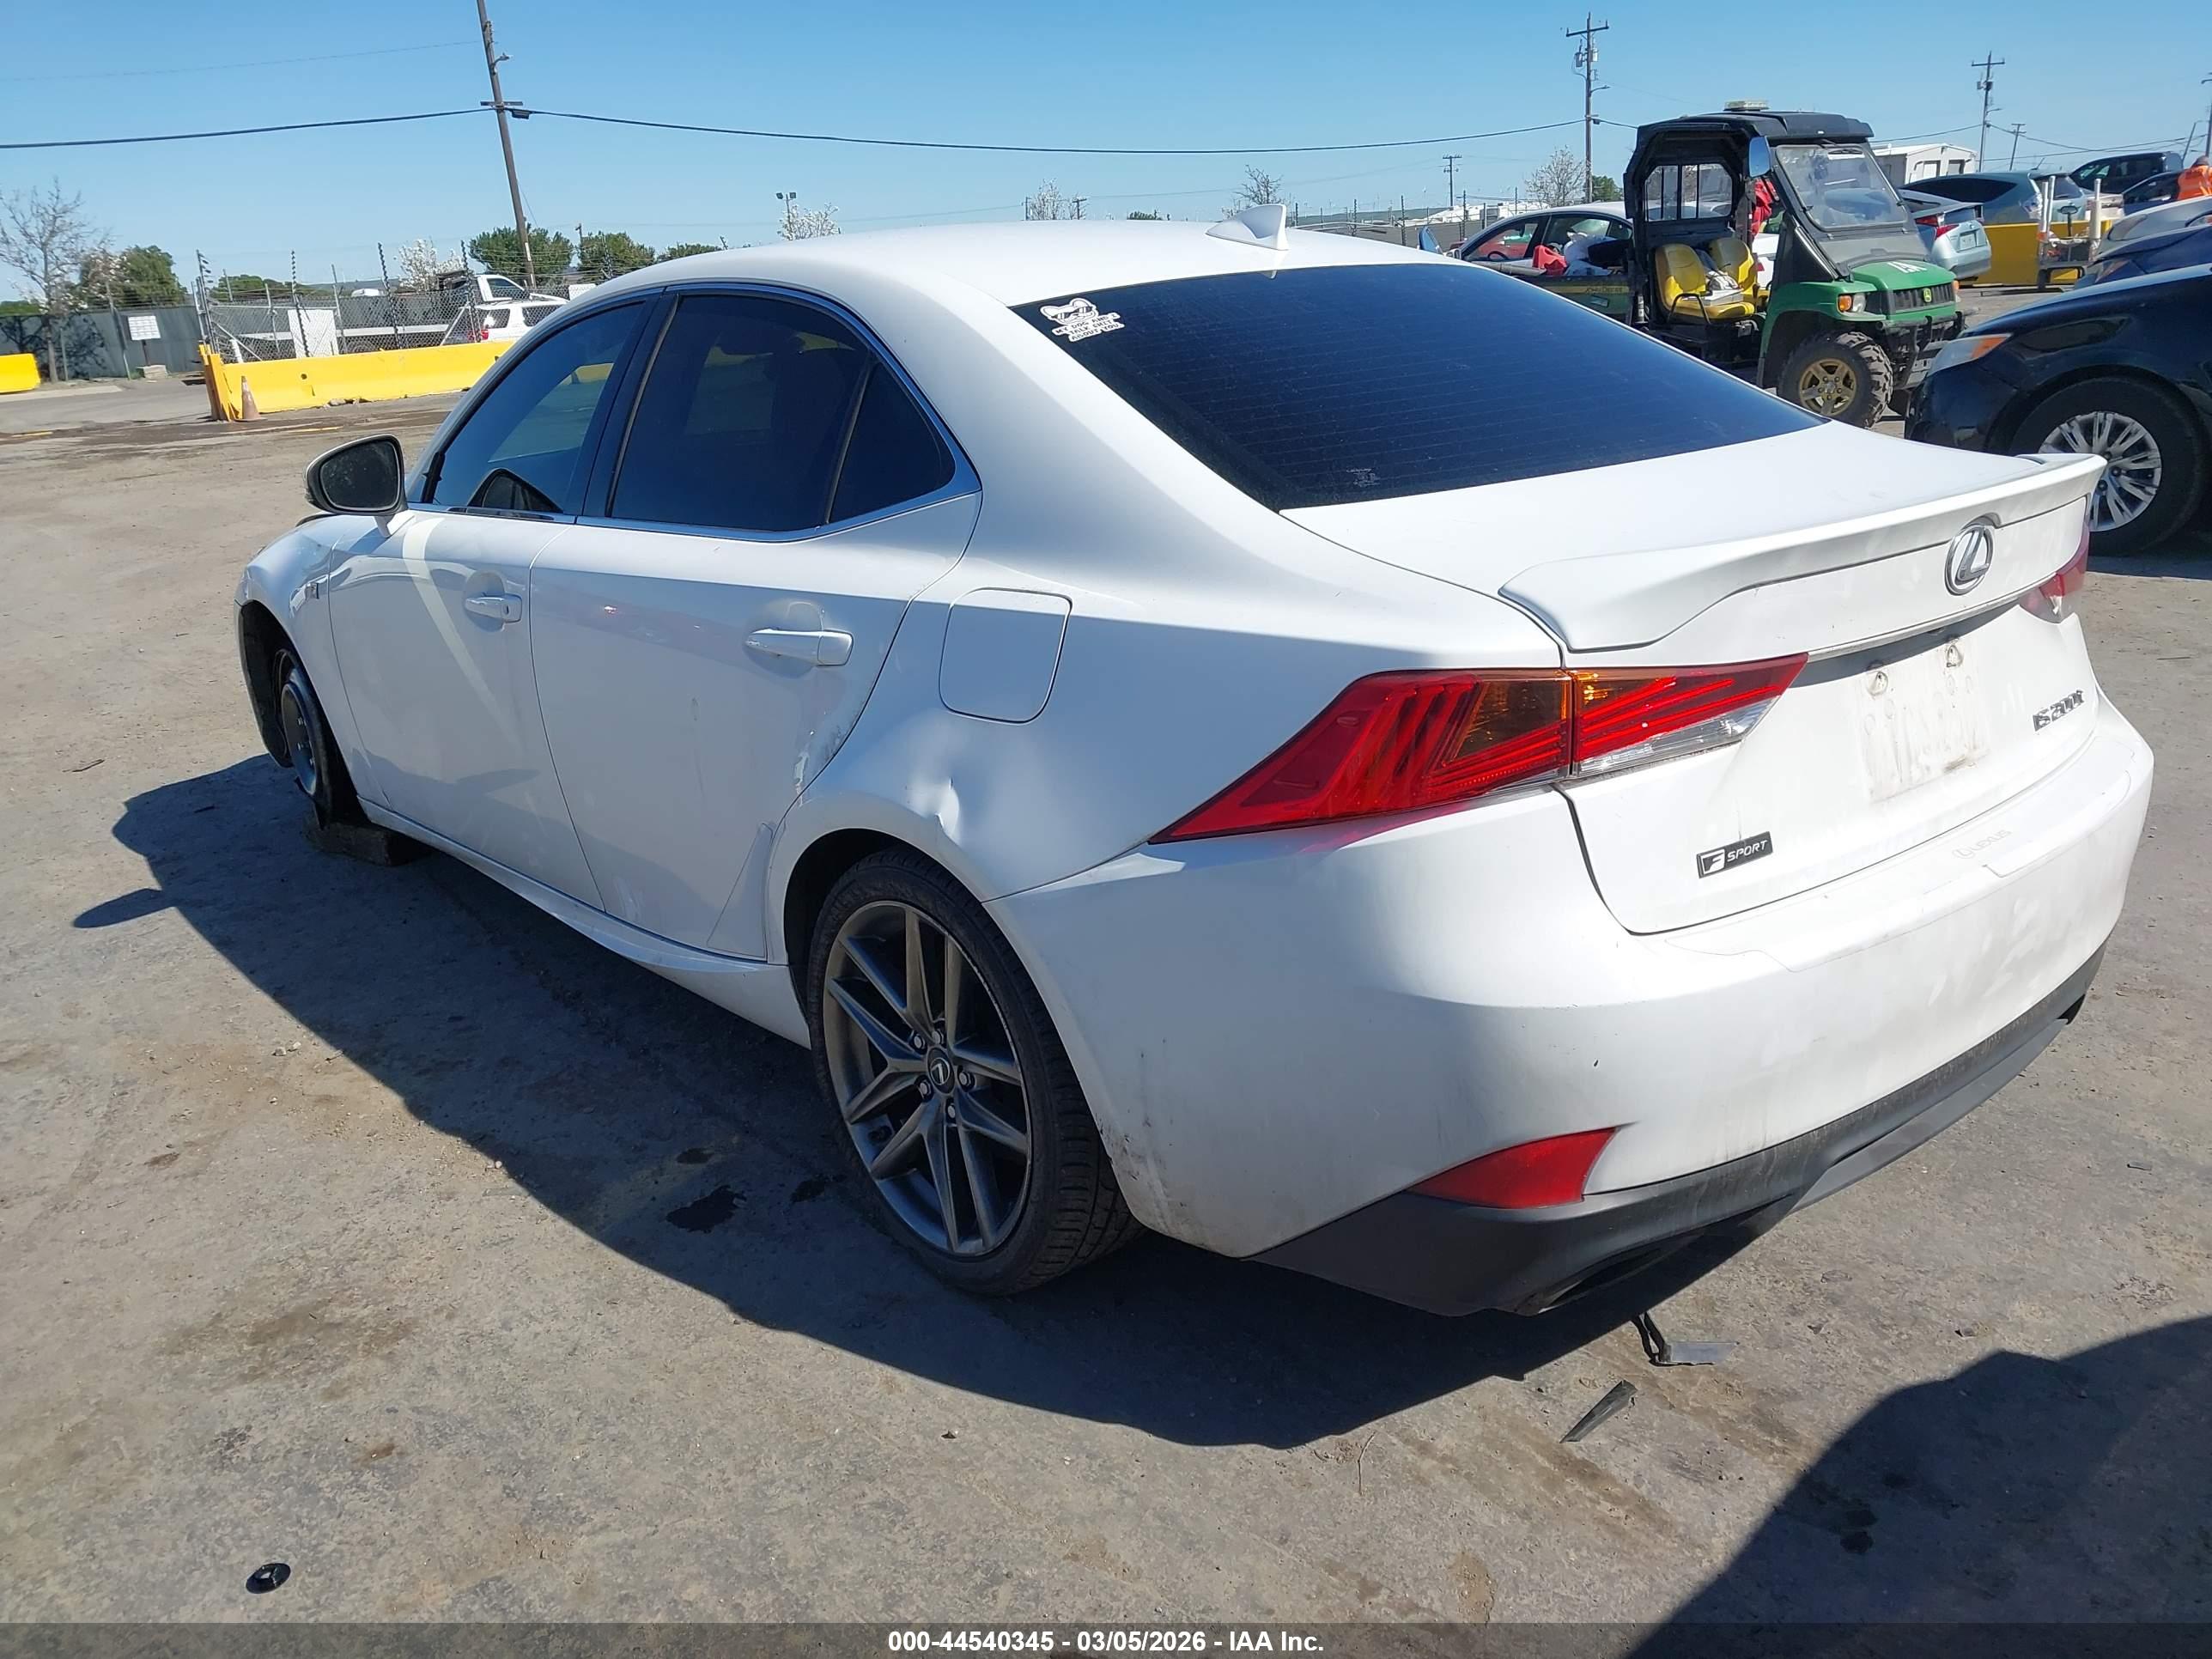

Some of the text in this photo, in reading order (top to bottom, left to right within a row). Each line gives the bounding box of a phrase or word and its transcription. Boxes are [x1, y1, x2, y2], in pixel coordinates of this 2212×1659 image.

[1069, 325, 1089, 335] TALK
[1072, 329, 1099, 341] ABOUT
[1727, 840, 1768, 862] SPORT
